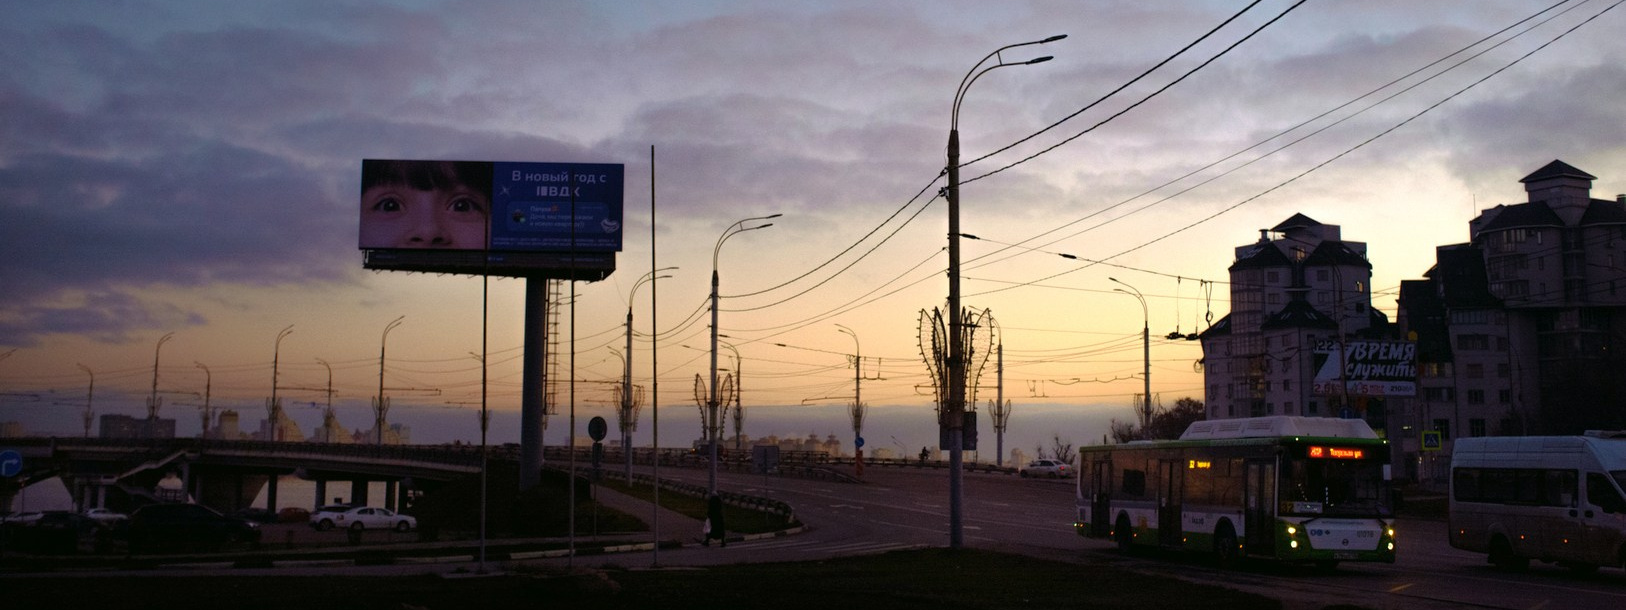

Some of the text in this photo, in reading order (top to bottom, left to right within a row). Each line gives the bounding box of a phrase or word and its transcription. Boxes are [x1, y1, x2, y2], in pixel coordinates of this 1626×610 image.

[512, 170, 607, 184] В новый год с
[1354, 341, 1415, 361] ВРЕМЯ
